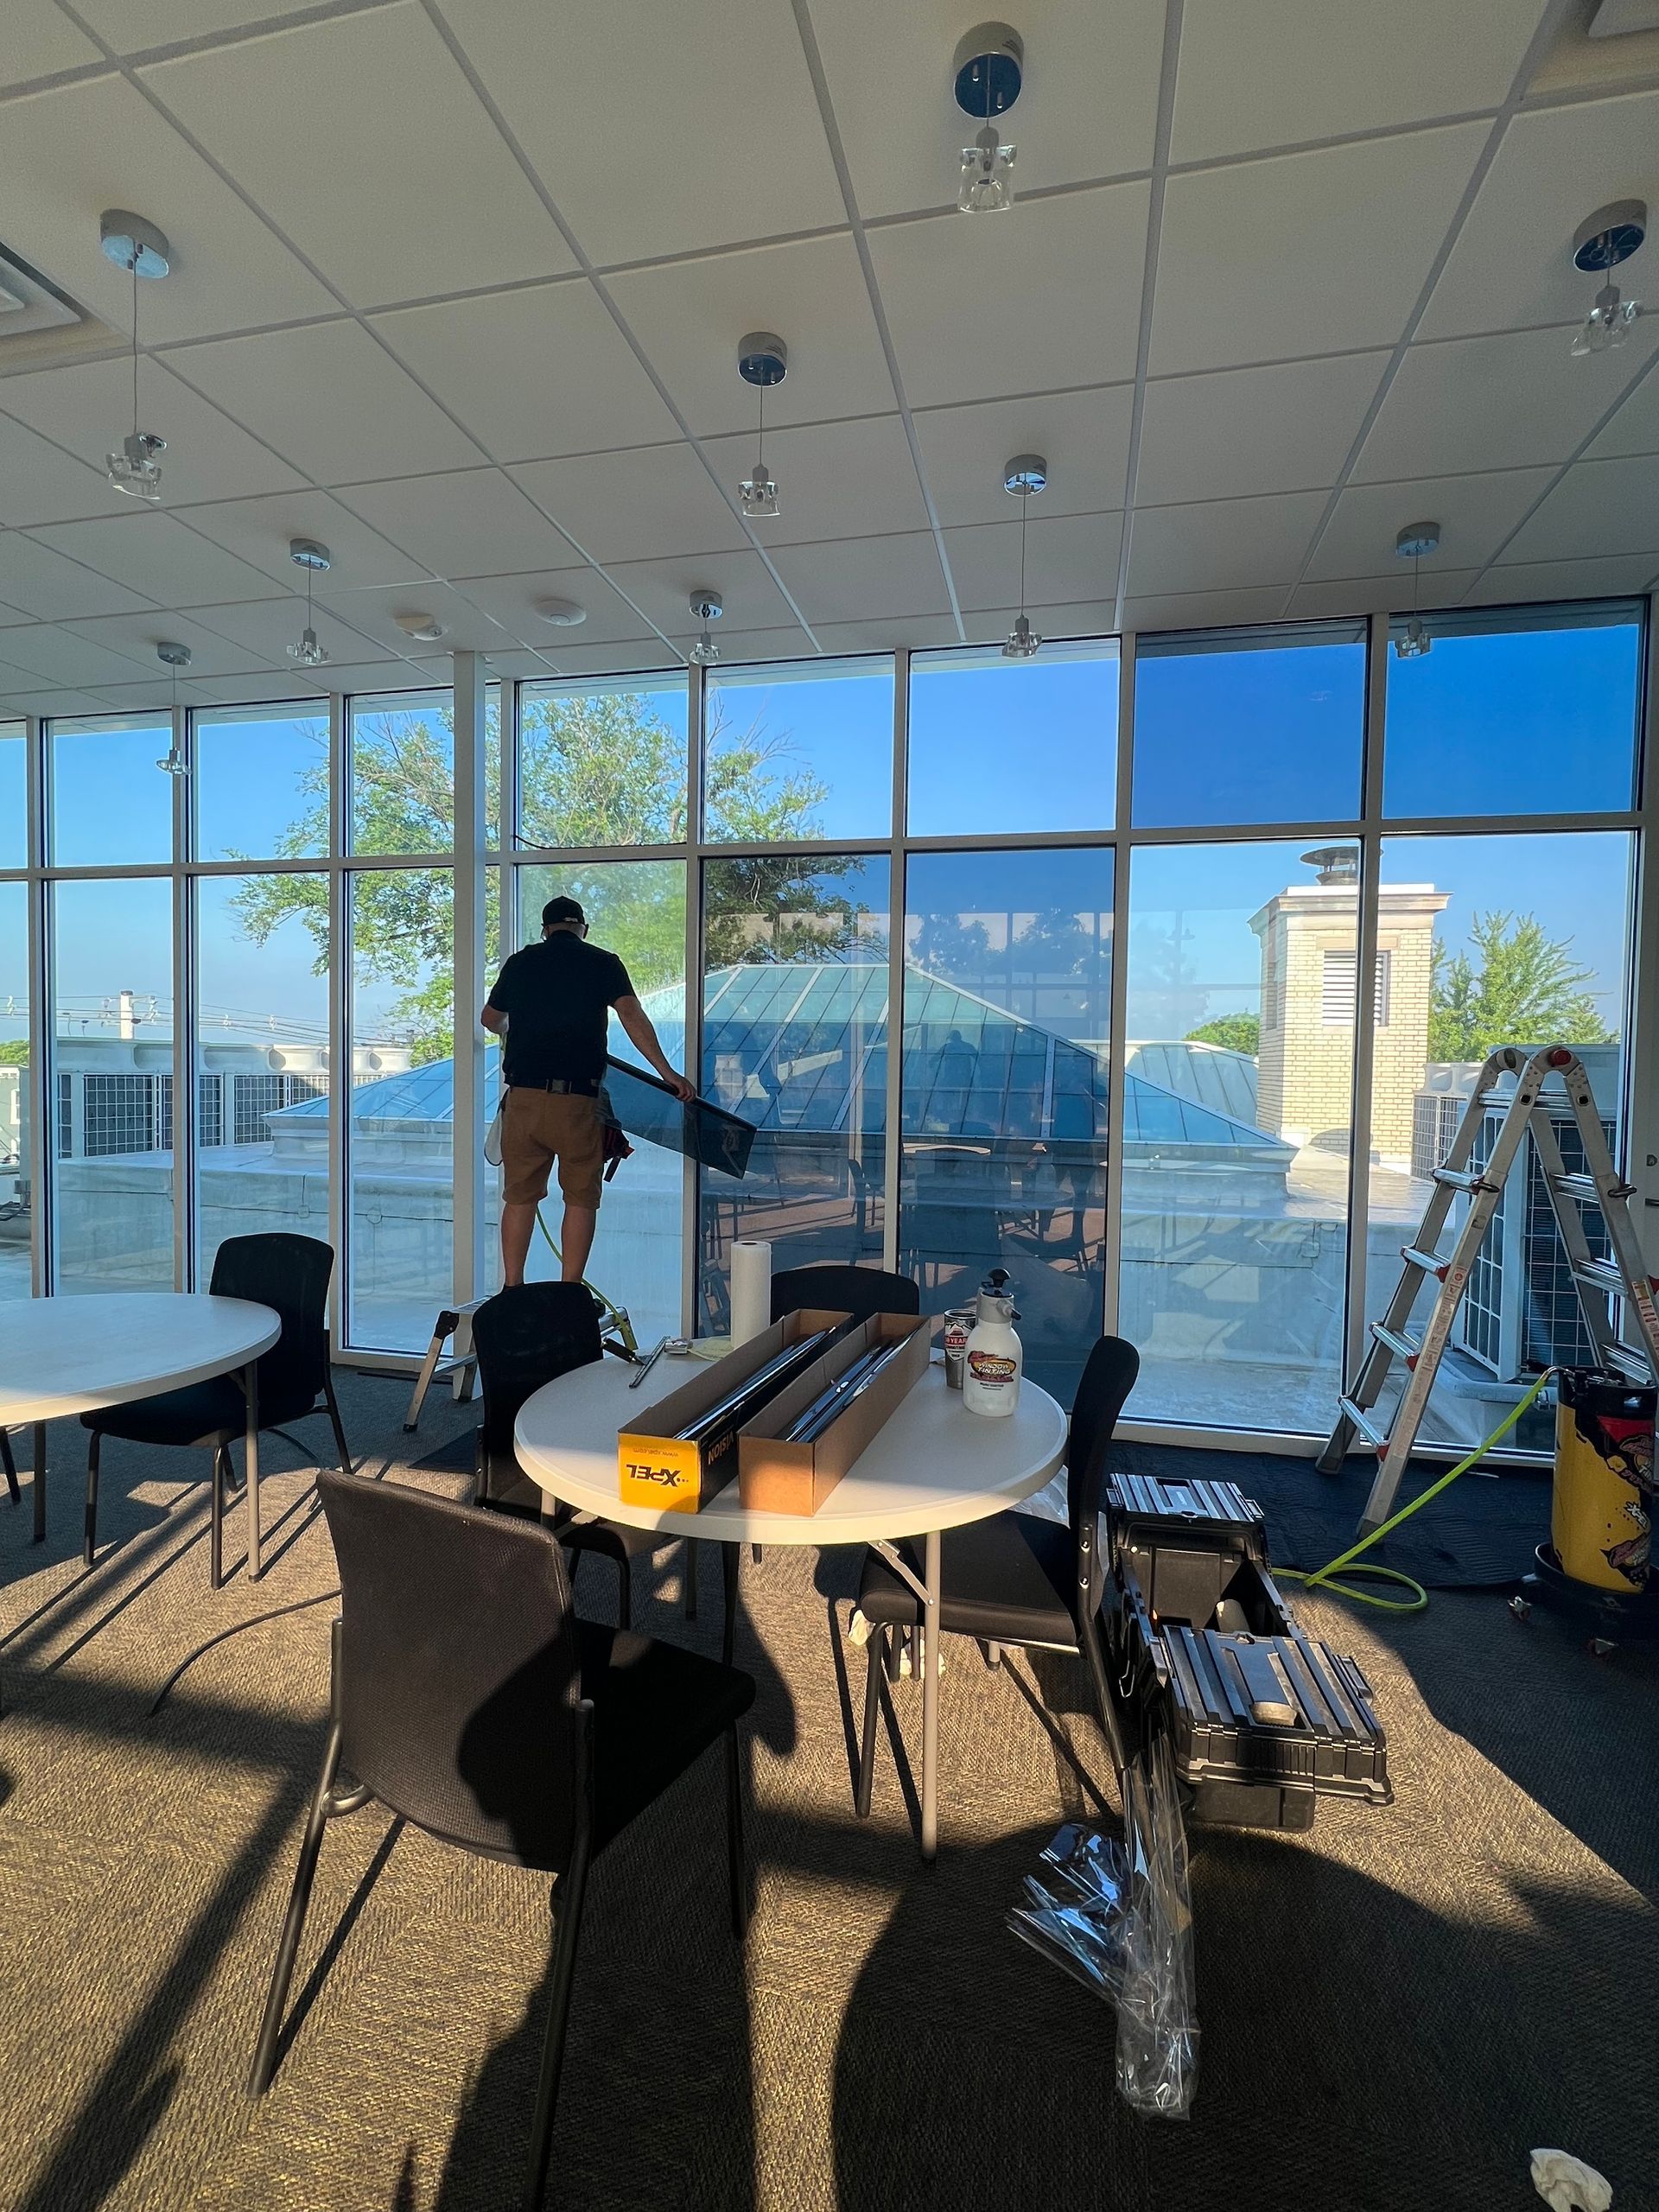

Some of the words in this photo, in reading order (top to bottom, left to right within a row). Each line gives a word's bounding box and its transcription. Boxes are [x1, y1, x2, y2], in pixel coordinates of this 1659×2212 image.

[632, 1447, 679, 1458] www.xpel.com
[708, 1430, 734, 1465] VISION
[626, 1464, 681, 1488] XPEL
[1626, 1503, 1648, 1529] XPEL
